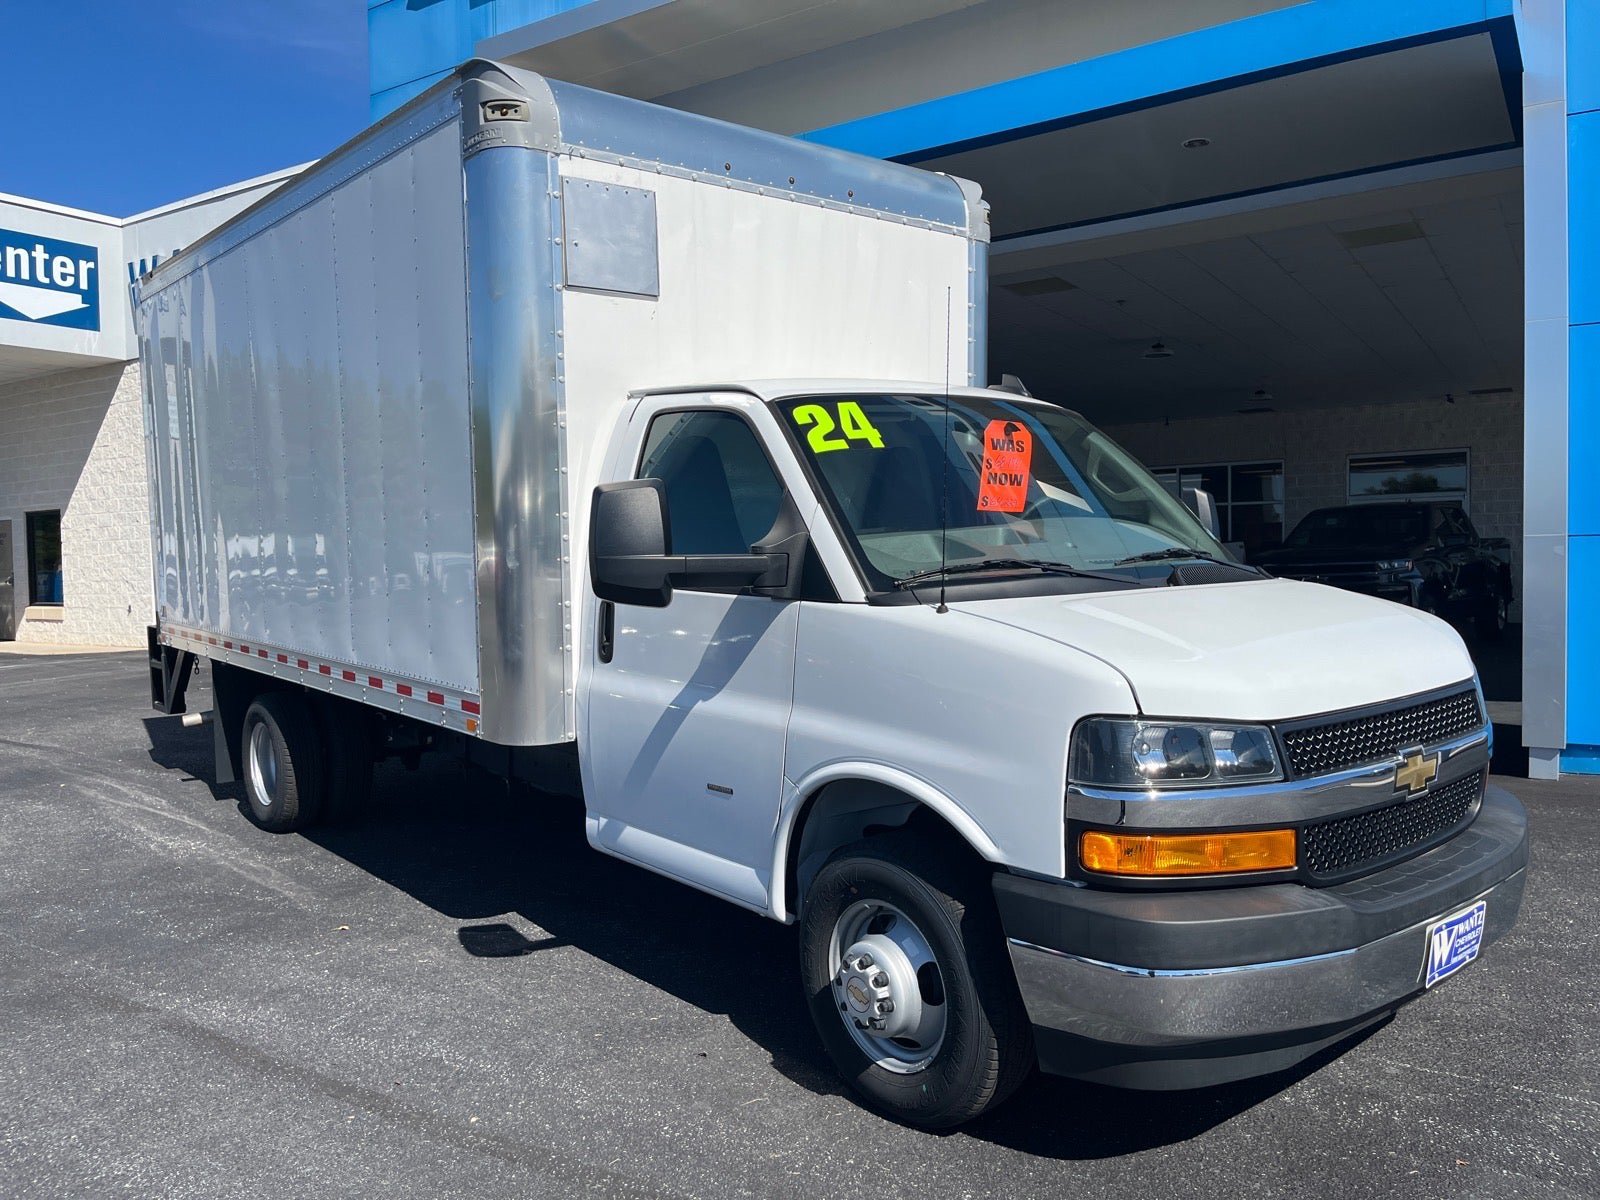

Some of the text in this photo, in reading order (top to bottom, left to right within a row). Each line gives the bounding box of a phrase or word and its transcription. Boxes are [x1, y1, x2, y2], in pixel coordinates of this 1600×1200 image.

[0, 244, 95, 290] nter
[793, 402, 885, 453] 24
[991, 437, 1025, 453] WAS
[987, 471, 1023, 487] NOW
[1459, 911, 1484, 936] WANTZ
